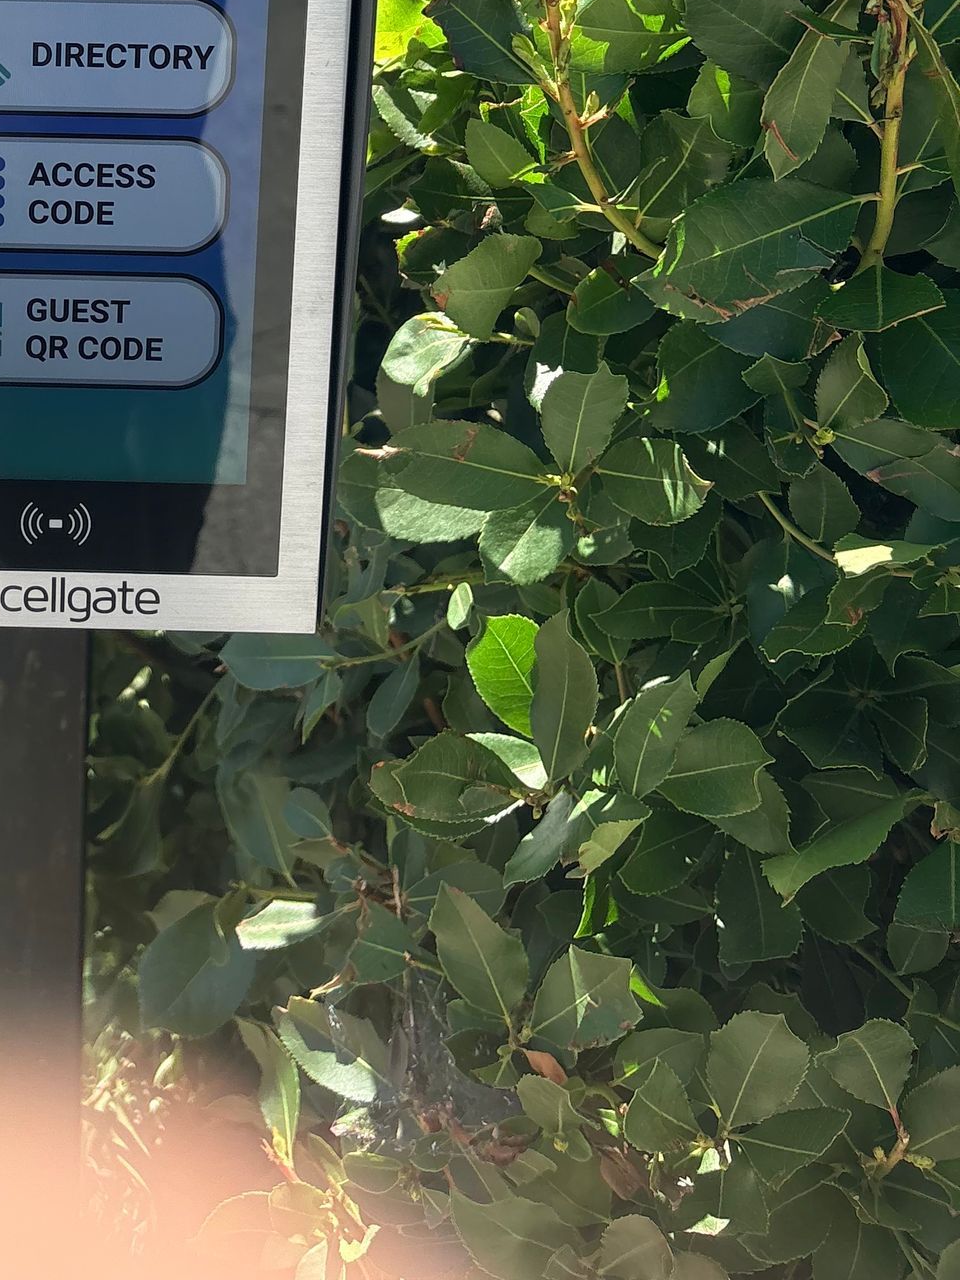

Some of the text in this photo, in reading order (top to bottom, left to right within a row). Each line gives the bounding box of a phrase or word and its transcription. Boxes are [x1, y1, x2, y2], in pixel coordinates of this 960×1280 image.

[32, 41, 215, 70] DIRECTORY
[28, 162, 156, 189] ACCESS
[28, 199, 115, 226] CODE
[26, 297, 131, 324] GUEST
[25, 334, 164, 362] QR CODE
[0, 577, 161, 622] cellgate
